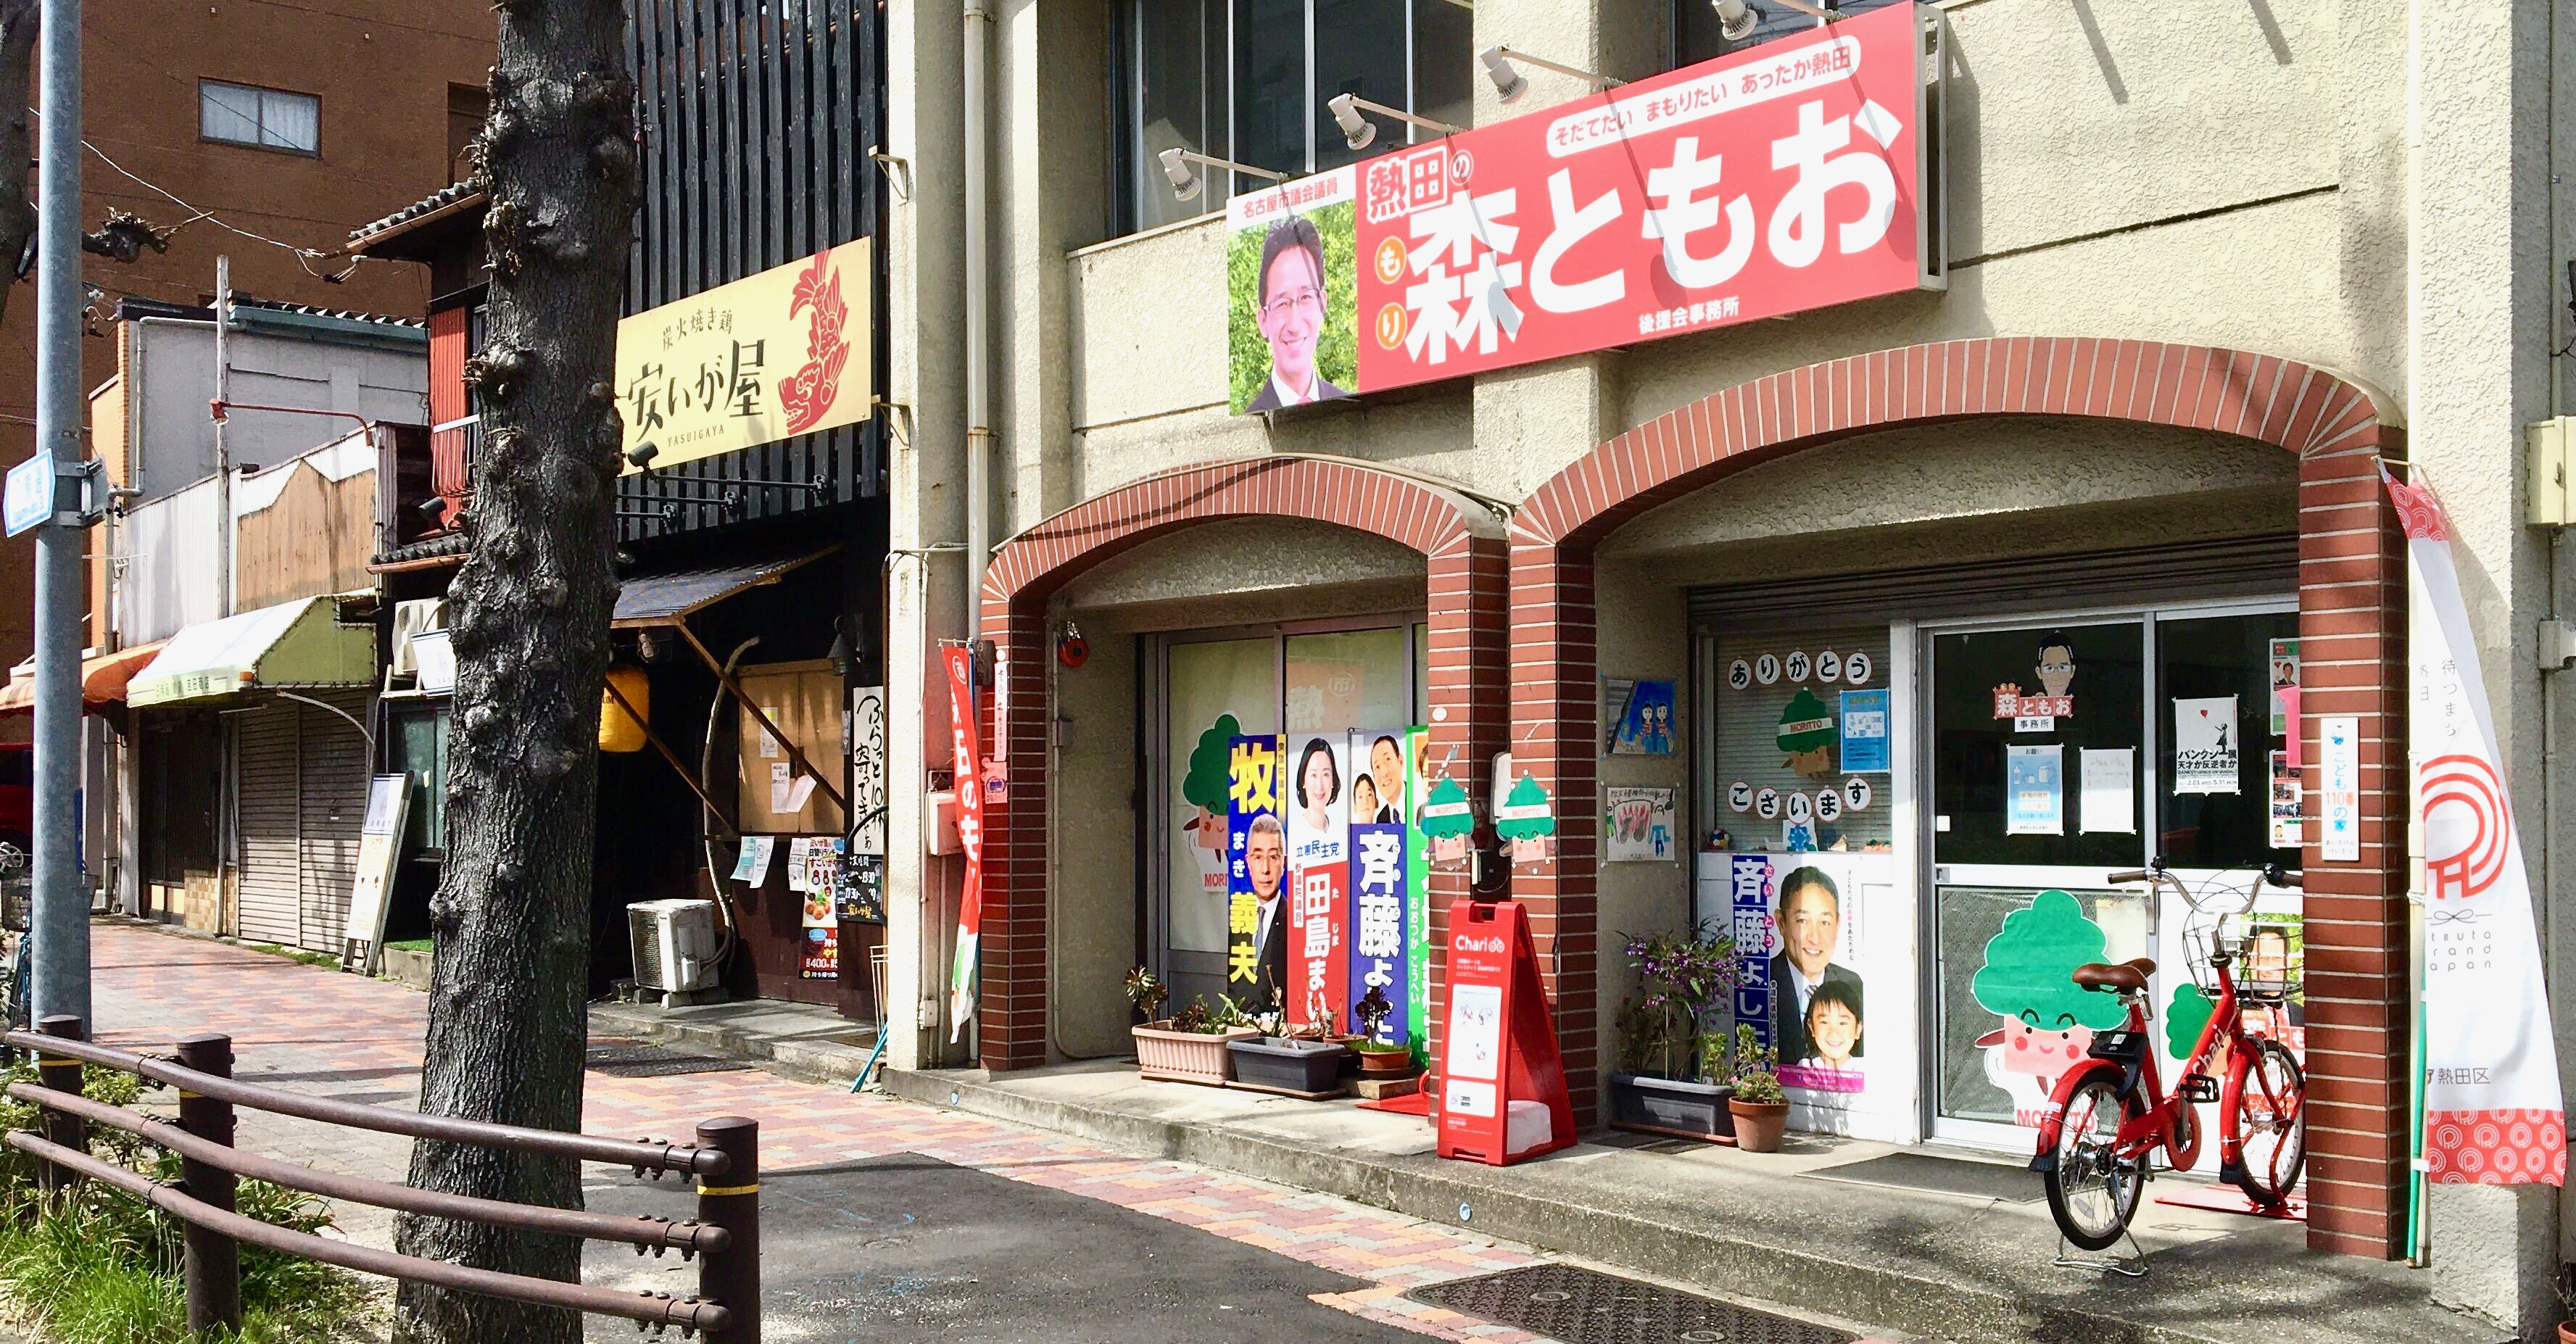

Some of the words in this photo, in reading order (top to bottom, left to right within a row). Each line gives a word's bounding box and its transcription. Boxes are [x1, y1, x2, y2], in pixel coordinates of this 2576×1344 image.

[1554, 111, 1633, 146] そだてたい
[1646, 82, 1727, 123] まもりたい
[1741, 45, 1851, 95] あったか熱田
[1243, 176, 1338, 220] 名古屋市議会議員
[1368, 147, 1472, 223] 熱田の
[1404, 99, 1903, 365] 森ともお
[1379, 245, 1401, 344] もり
[1639, 294, 1740, 334] 後援会事務所
[628, 339, 766, 442] 安いが屋
[667, 424, 724, 447] YASUIGAYA
[1731, 654, 1865, 685] ありがとう
[1789, 719, 1823, 733] MORITTO
[1997, 692, 2071, 716] 森ともお
[2020, 718, 2050, 729] 事務所
[2178, 748, 2237, 760] バンクシー展
[1229, 742, 1276, 814] 牧
[2325, 752, 2356, 832] こども110番の家
[1435, 805, 1463, 816] MORITTO
[1512, 808, 1541, 818] MORITTO
[1232, 831, 1246, 878] まき
[1296, 839, 1340, 858] 立憲民主党
[1294, 862, 1303, 924] 参議院議員
[1763, 864, 1775, 948] さいとう
[1229, 891, 1259, 985] 義夫
[1409, 897, 1420, 950] おおつか
[1455, 934, 1488, 953] Chari
[1410, 955, 1420, 1005] こうへい
